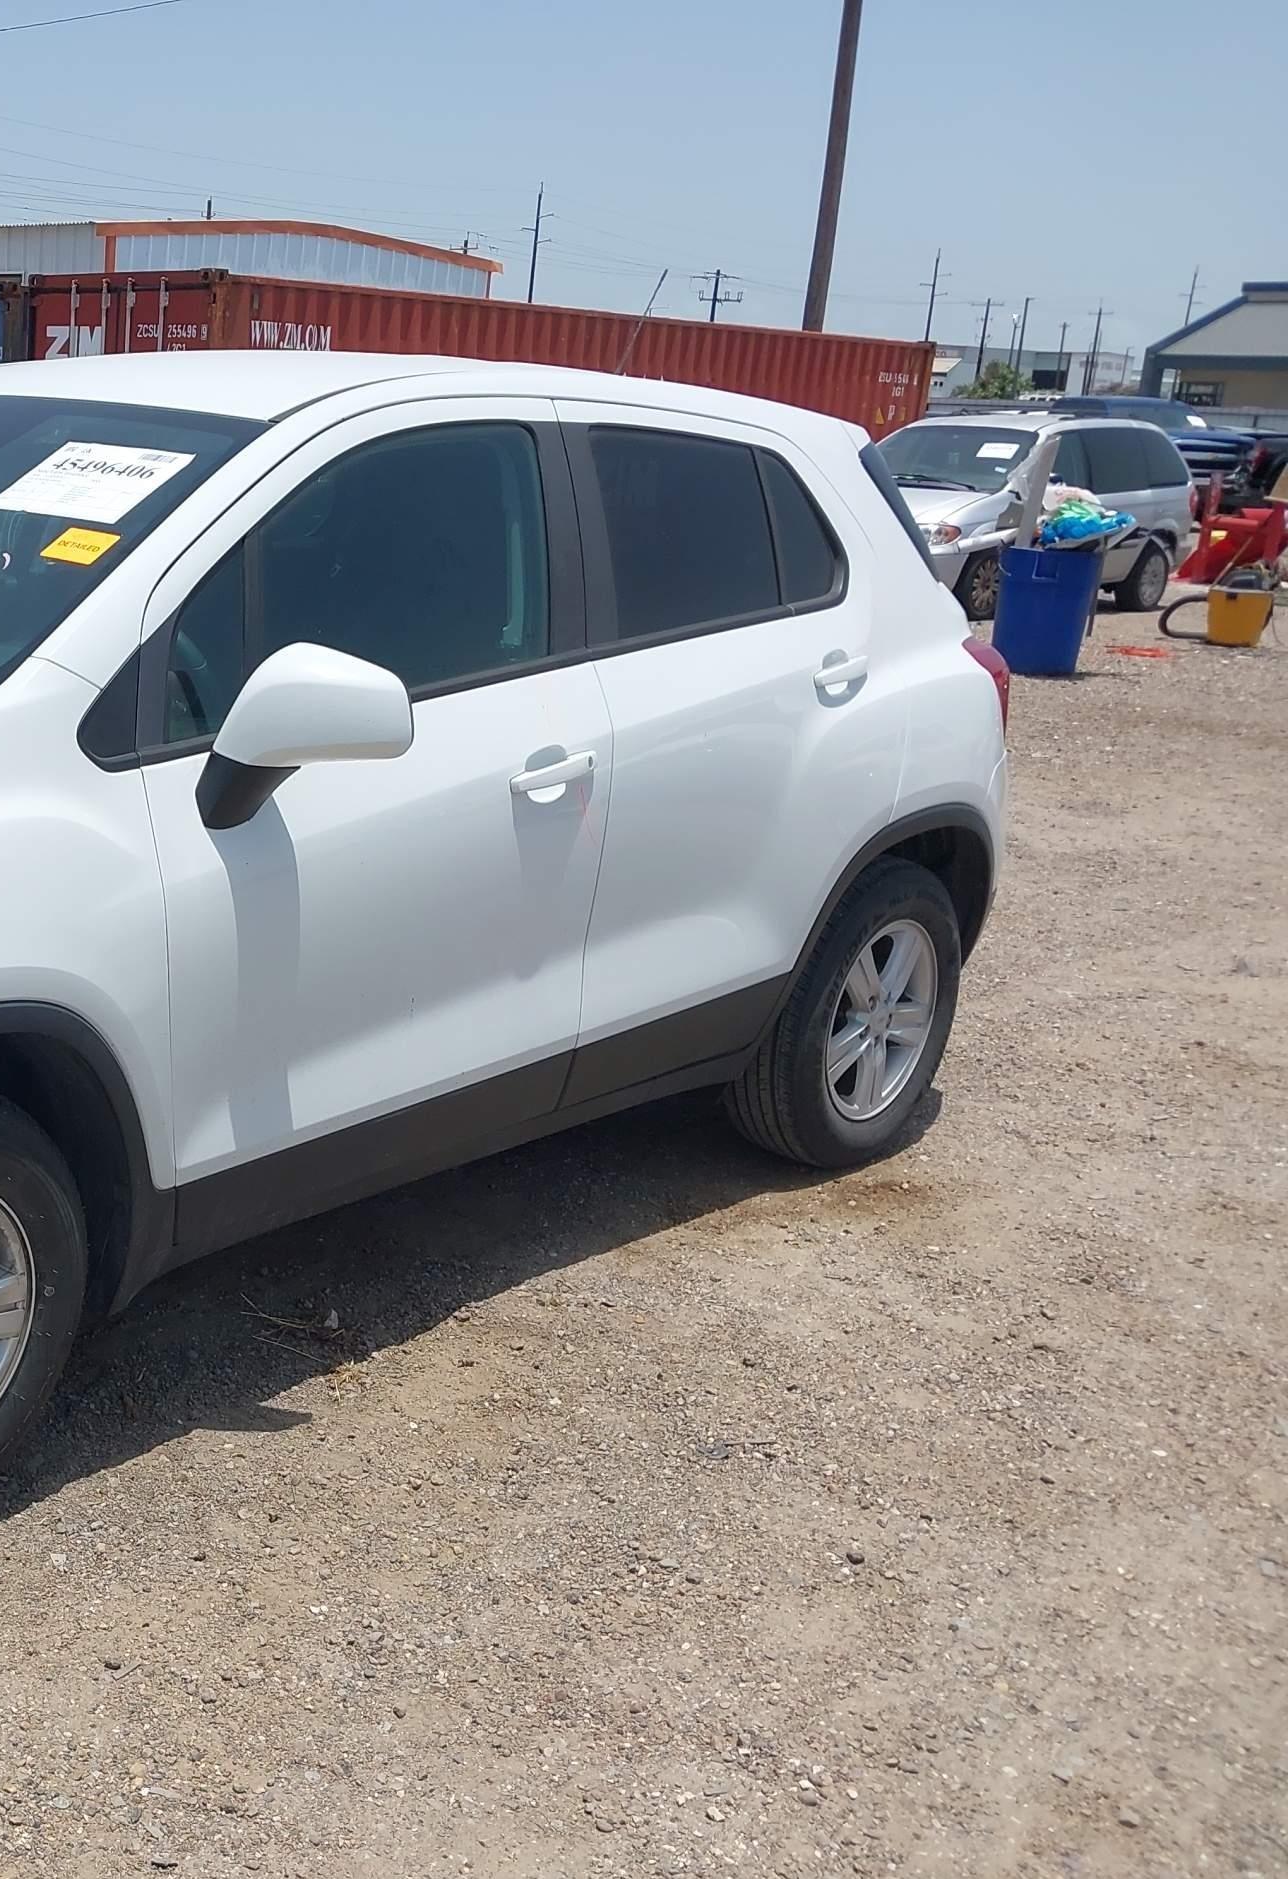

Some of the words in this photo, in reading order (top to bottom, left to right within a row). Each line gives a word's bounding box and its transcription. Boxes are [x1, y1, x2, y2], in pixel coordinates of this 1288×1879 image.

[136, 324, 159, 338] ZCSU
[167, 324, 197, 338] 255496
[200, 324, 207, 340] 9
[45, 326, 105, 360] ZIM
[53, 457, 159, 479] 45496406
[58, 540, 101, 552] DETAILED
